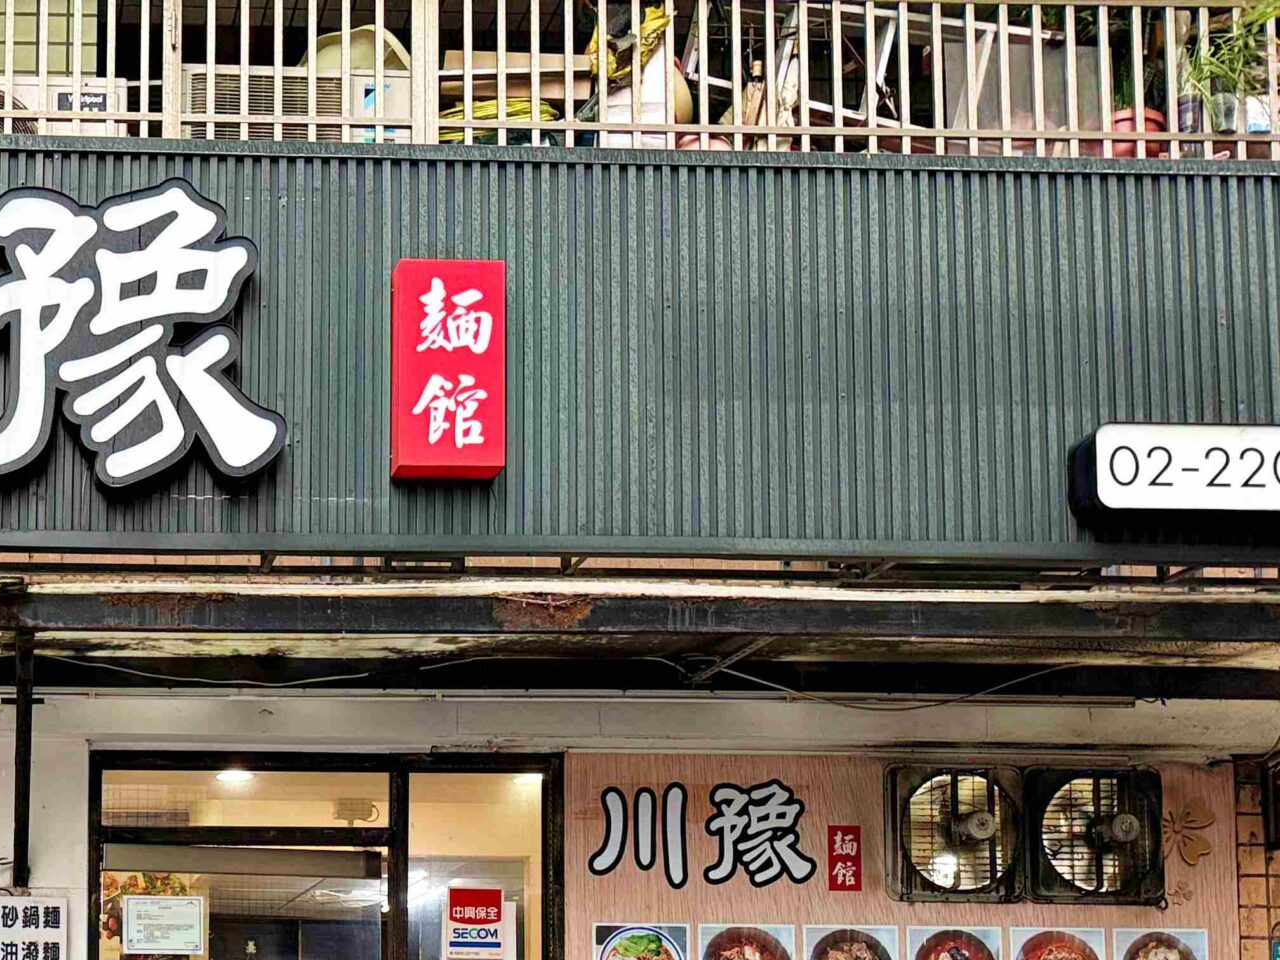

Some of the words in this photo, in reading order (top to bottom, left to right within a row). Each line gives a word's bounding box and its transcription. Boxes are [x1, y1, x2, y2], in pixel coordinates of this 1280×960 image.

[412, 277, 493, 448] 麵館
[1109, 445, 1280, 488] 02-22
[589, 778, 817, 889] 川豫
[831, 829, 858, 889] 麵館
[452, 906, 498, 920] 中興保全
[452, 928, 498, 939] SECOM
